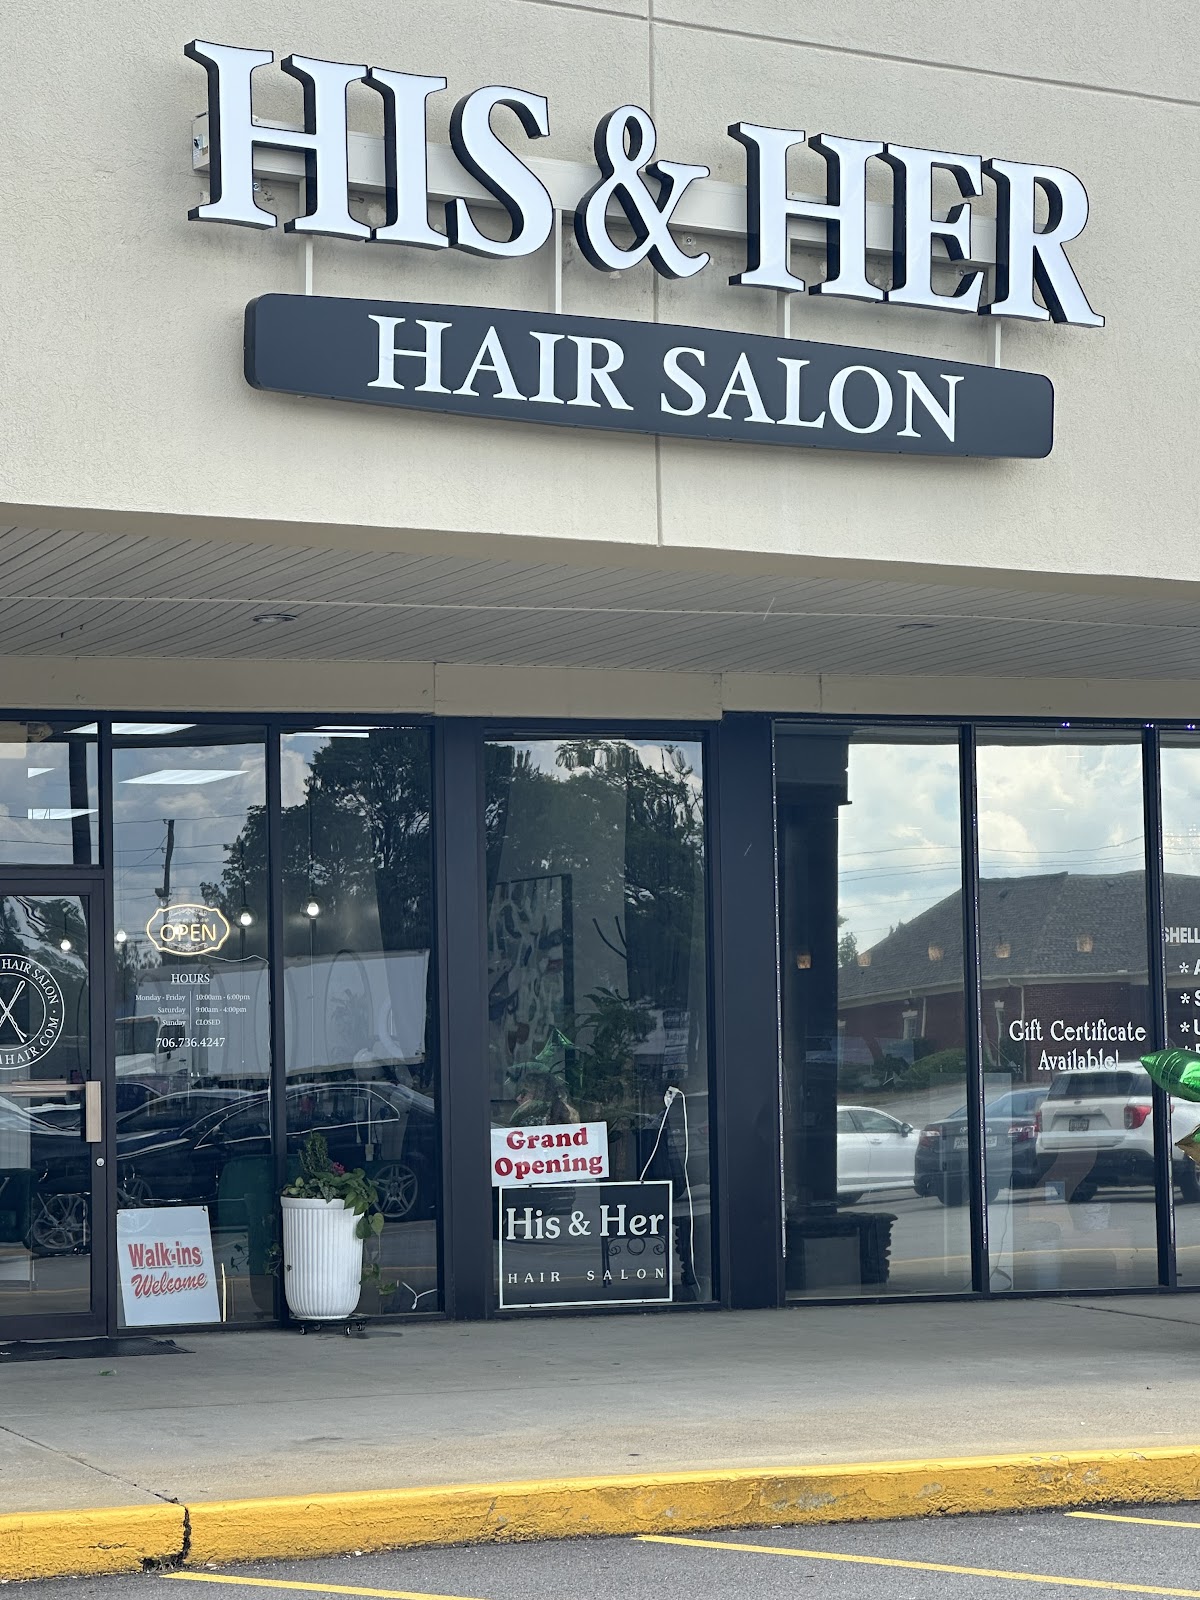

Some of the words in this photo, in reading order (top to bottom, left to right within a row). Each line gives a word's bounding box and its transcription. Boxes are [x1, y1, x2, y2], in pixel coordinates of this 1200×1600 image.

[185, 39, 552, 259] HIS
[575, 104, 710, 278] &
[728, 121, 1105, 328] HER
[367, 314, 634, 411] HAIR
[659, 346, 965, 443] SALON
[160, 923, 216, 942] OPEN
[2, 959, 31, 974] HAIR
[31, 968, 59, 1004] SALON
[171, 973, 210, 984] HOURS
[135, 994, 161, 1003] Monday
[165, 994, 186, 1003] Friday
[226, 994, 250, 1002] 6:00pm
[162, 1019, 186, 1027] Sunday
[1008, 1019, 1043, 1042] Gift
[1050, 1019, 1146, 1042] Certificate
[155, 1037, 225, 1048] 706.736.4247
[1038, 1048, 1119, 1071] Available!
[506, 1127, 589, 1150] Grand
[494, 1154, 603, 1179] Opening
[506, 1207, 561, 1240] His
[568, 1210, 591, 1237] &
[599, 1204, 664, 1237] Her
[128, 1241, 203, 1270] Walk-ins
[131, 1271, 207, 1299] Welcome
[507, 1271, 561, 1284] HAIR
[586, 1268, 665, 1282] SALON
